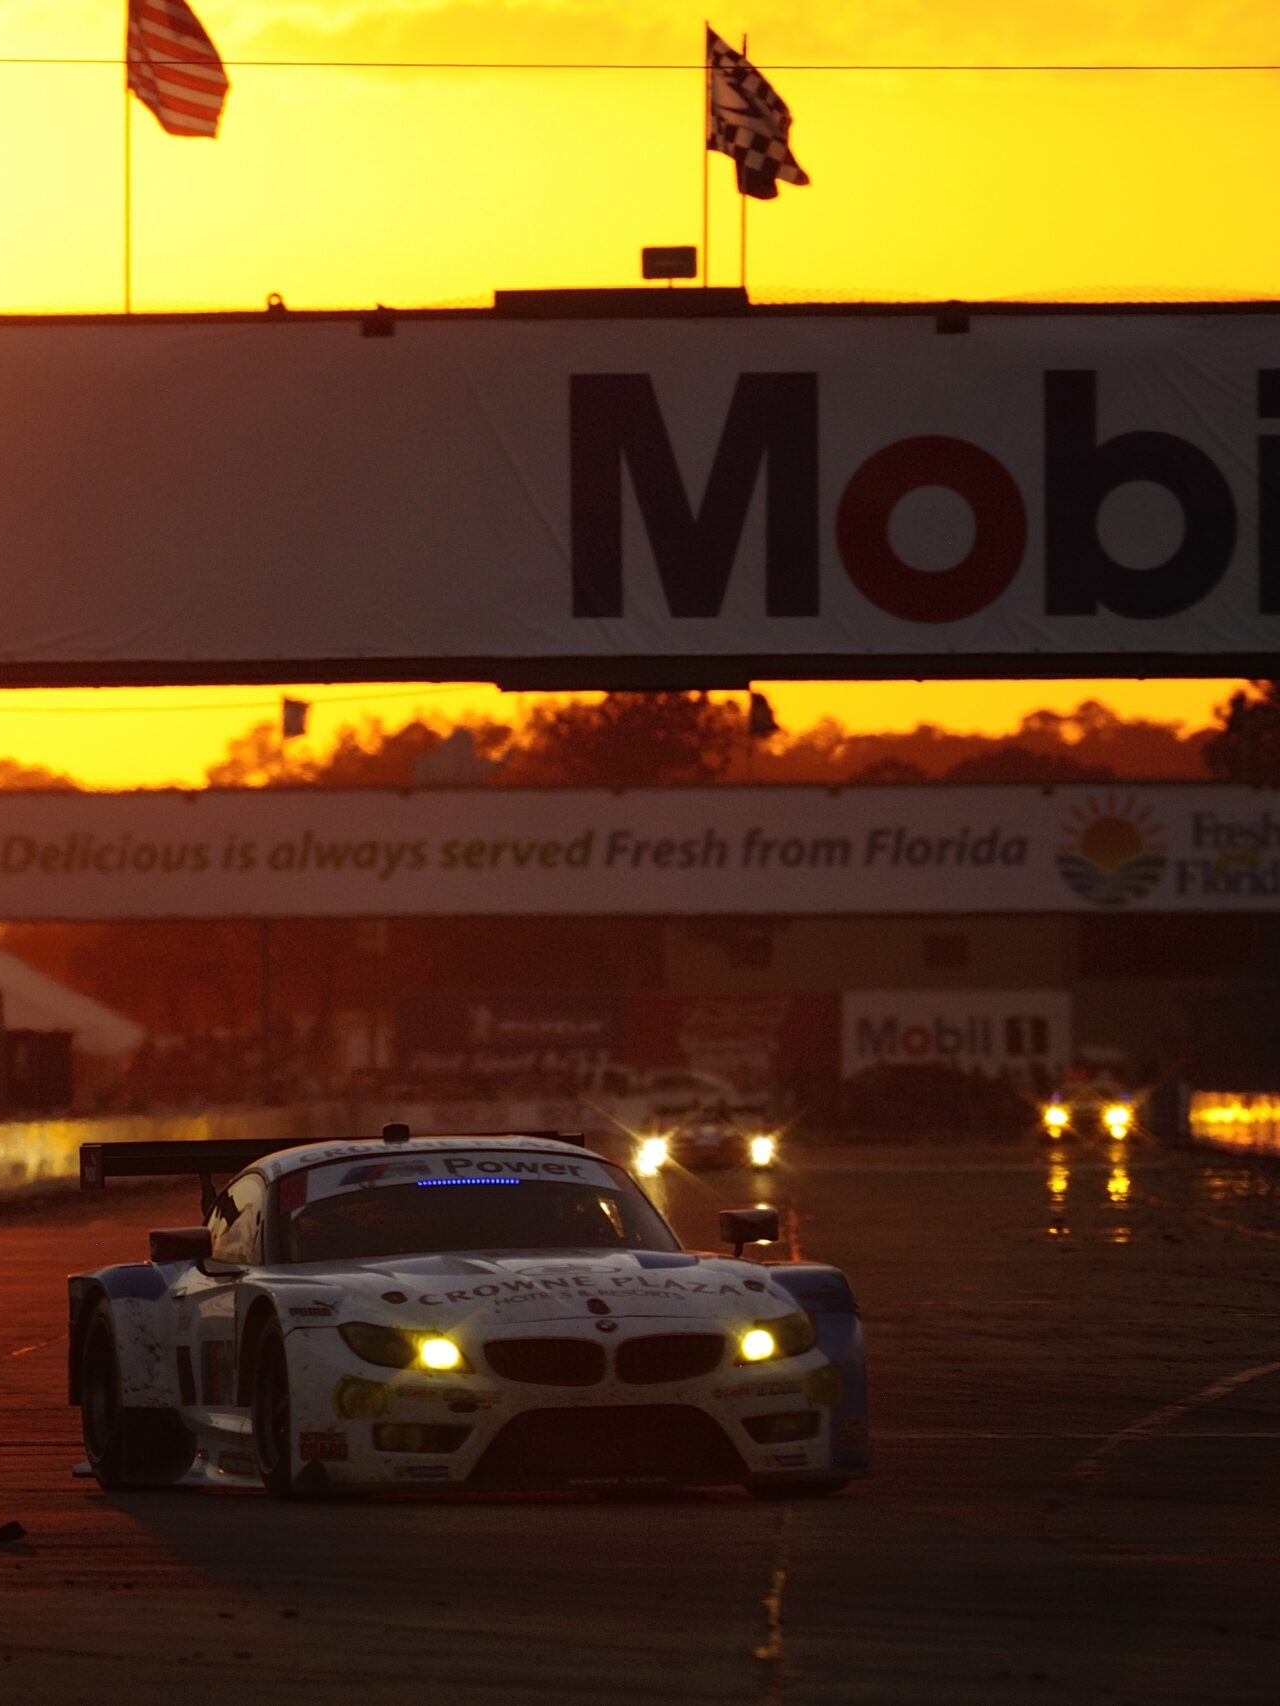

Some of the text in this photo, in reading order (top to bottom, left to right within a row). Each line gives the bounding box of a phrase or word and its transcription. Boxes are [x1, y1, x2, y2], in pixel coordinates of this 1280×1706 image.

[0, 825, 1029, 881] Delicious is always served Fresh from Florida
[1176, 857, 1280, 895] Florid
[855, 1014, 993, 1057] Mobil
[439, 1157, 584, 1177] Power
[418, 1275, 743, 1306] CROWNE PLAZA
[494, 1290, 572, 1306] HOTES
